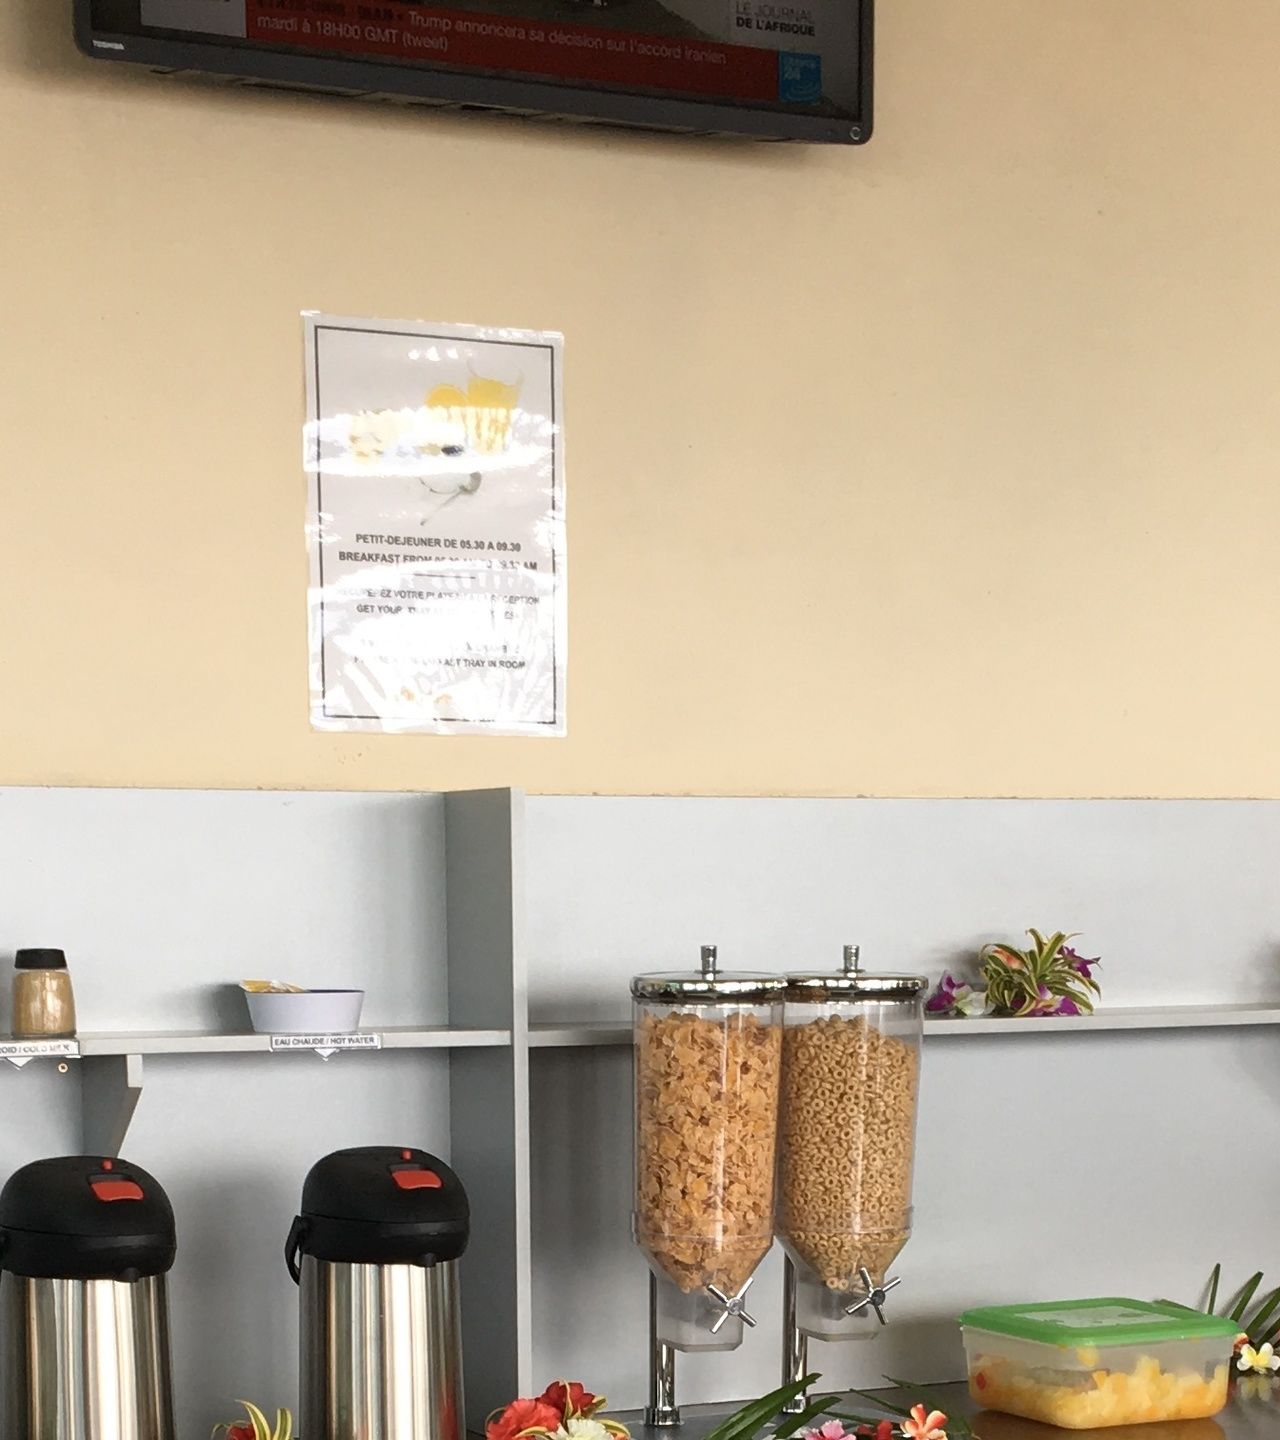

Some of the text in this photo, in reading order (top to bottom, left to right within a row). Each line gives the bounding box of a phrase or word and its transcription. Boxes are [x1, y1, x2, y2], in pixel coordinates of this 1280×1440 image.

[257, 16, 298, 32] mardi
[316, 21, 361, 39] 18H00
[365, 26, 399, 44] GMT
[402, 32, 448, 53] (tweet)
[408, 10, 451, 32] Trump
[455, 20, 526, 40] annoncera
[528, 30, 545, 42] sa
[548, 30, 603, 49] décision
[606, 40, 626, 52] sur
[736, 16, 816, 37] DE L'AFRIQUE
[355, 533, 521, 552] PETIT-DEJEUNER DE 05.30 A 09.30
[338, 551, 401, 563] BREAKFAST
[356, 603, 375, 613] GET
[274, 1038, 290, 1046] EAU
[292, 1038, 324, 1046] CHAUDE
[330, 1037, 347, 1045] HOT
[348, 1037, 375, 1045] WATER
